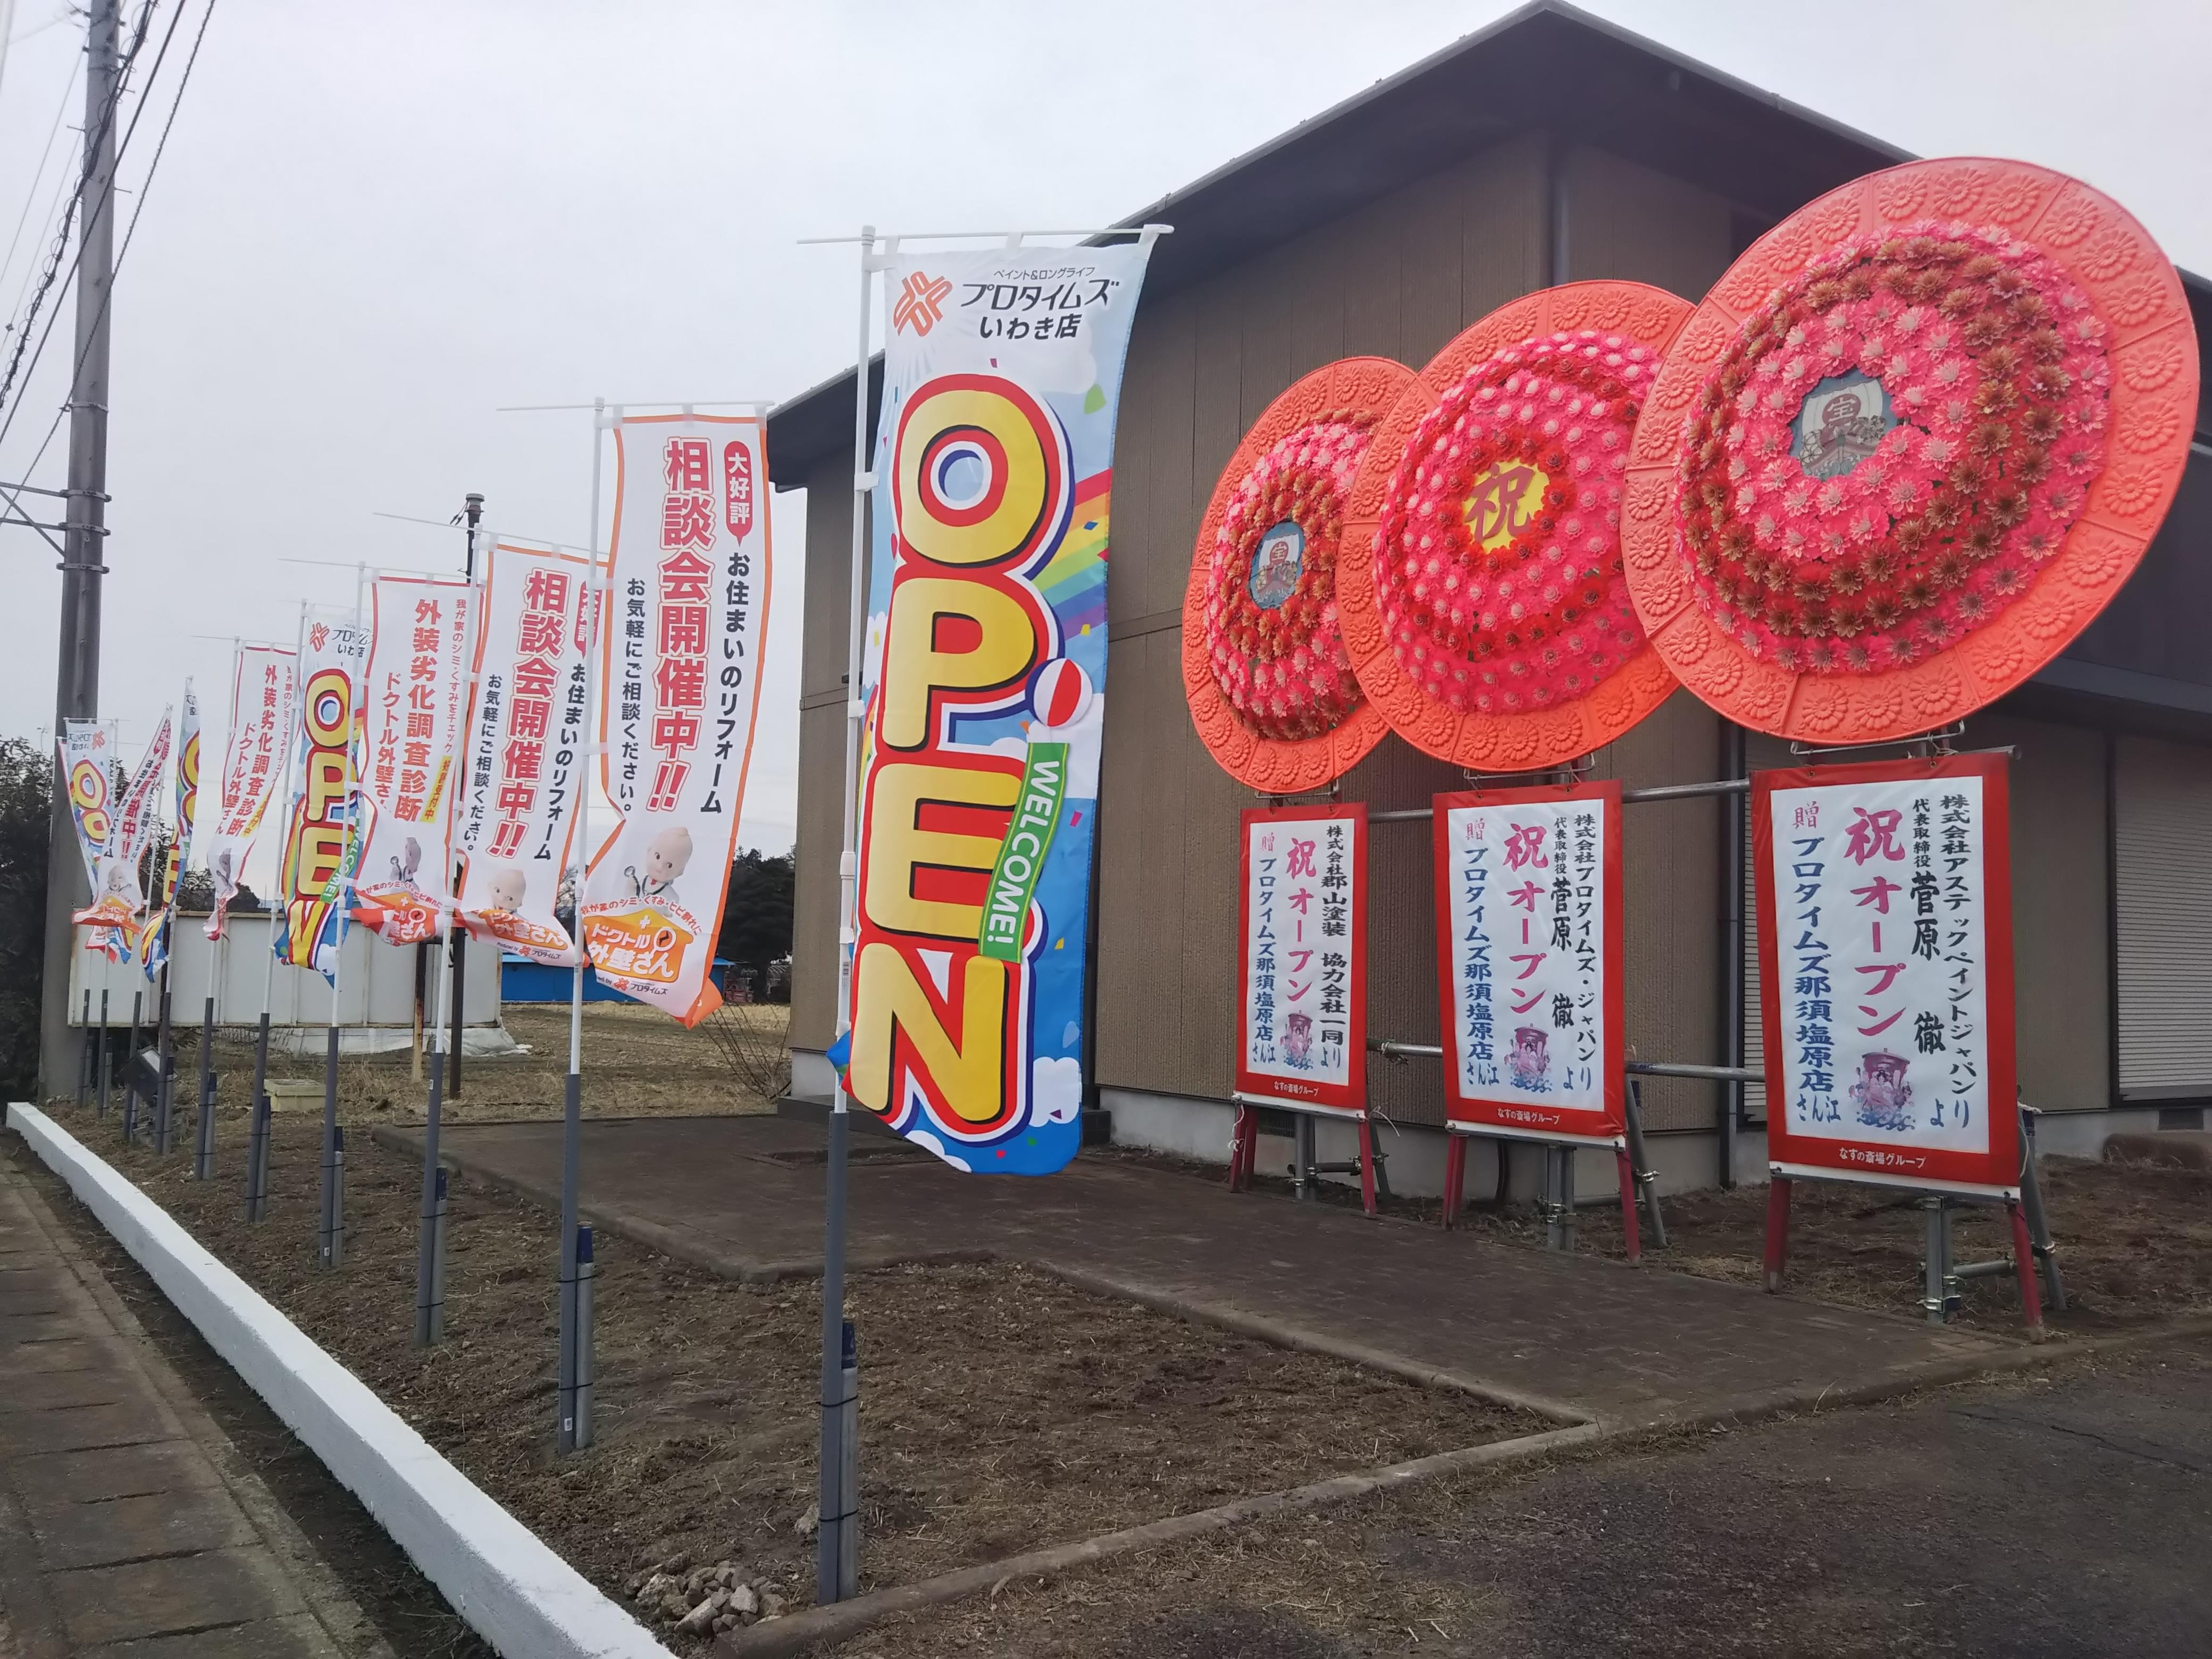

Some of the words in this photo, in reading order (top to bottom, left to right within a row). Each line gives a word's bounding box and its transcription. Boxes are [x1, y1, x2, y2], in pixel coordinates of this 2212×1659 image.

[994, 266, 1095, 280] ペイント&ロングライフ
[959, 279, 1120, 311] プロタイムズ
[979, 313, 1083, 340] いわき店
[1827, 397, 1856, 422] 宝
[728, 452, 750, 525] 大好評
[1464, 463, 1536, 544] 祝
[1272, 543, 1287, 561] 宝
[700, 552, 750, 815] お住まいのリフォーム
[393, 599, 442, 822] 外装劣化調査診断
[226, 664, 278, 837] 外装劣化調査診断
[848, 374, 1062, 1125] OPEN
[1792, 801, 1820, 830] 贈
[1261, 832, 1276, 853] 贈
[1465, 818, 1485, 842] 贈
[987, 760, 1060, 944] WELCOME!
[591, 923, 651, 949] ドクトル
[1254, 857, 1277, 1042] プロタイムズ那須塩原店
[532, 950, 562, 960] プロタイムズ
[588, 941, 674, 978] 外壁さん
[1464, 847, 1494, 1061] プロタイムズ那須塩原店
[1791, 836, 1835, 1094] プロタイムズ那須塩原店
[630, 983, 668, 995] プロタイムズ
[1320, 1046, 1340, 1069] より
[1273, 1080, 1319, 1097] なすの斎場グループ
[1562, 1065, 1591, 1092] より
[1497, 1107, 1560, 1126] なすの斎場グループ
[1930, 1097, 1970, 1129] より
[1839, 1146, 1926, 1170] なすの斎場グループ
